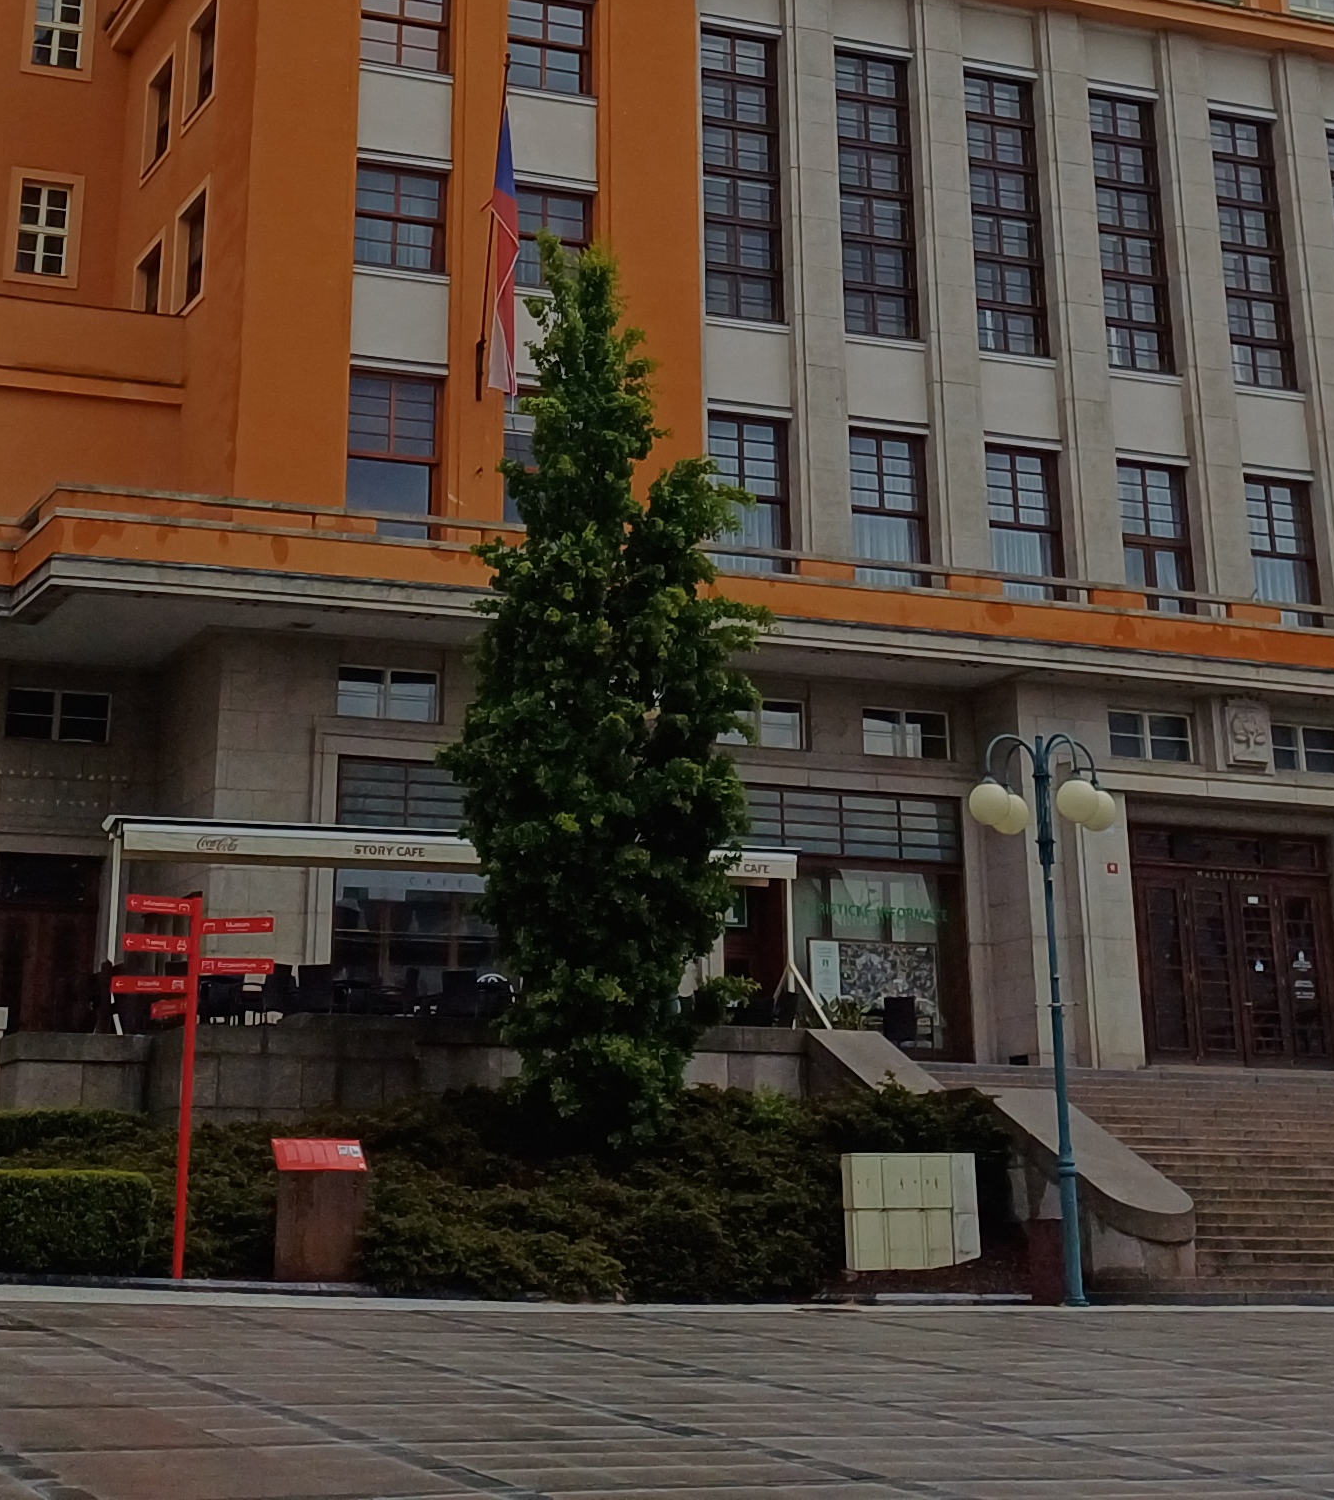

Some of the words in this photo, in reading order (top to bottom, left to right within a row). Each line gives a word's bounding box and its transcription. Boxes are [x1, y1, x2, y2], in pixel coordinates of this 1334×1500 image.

[353, 844, 394, 856] STORY
[396, 845, 426, 858] CAFE
[743, 863, 770, 874] CAFE
[876, 906, 948, 922] INFORMAE
